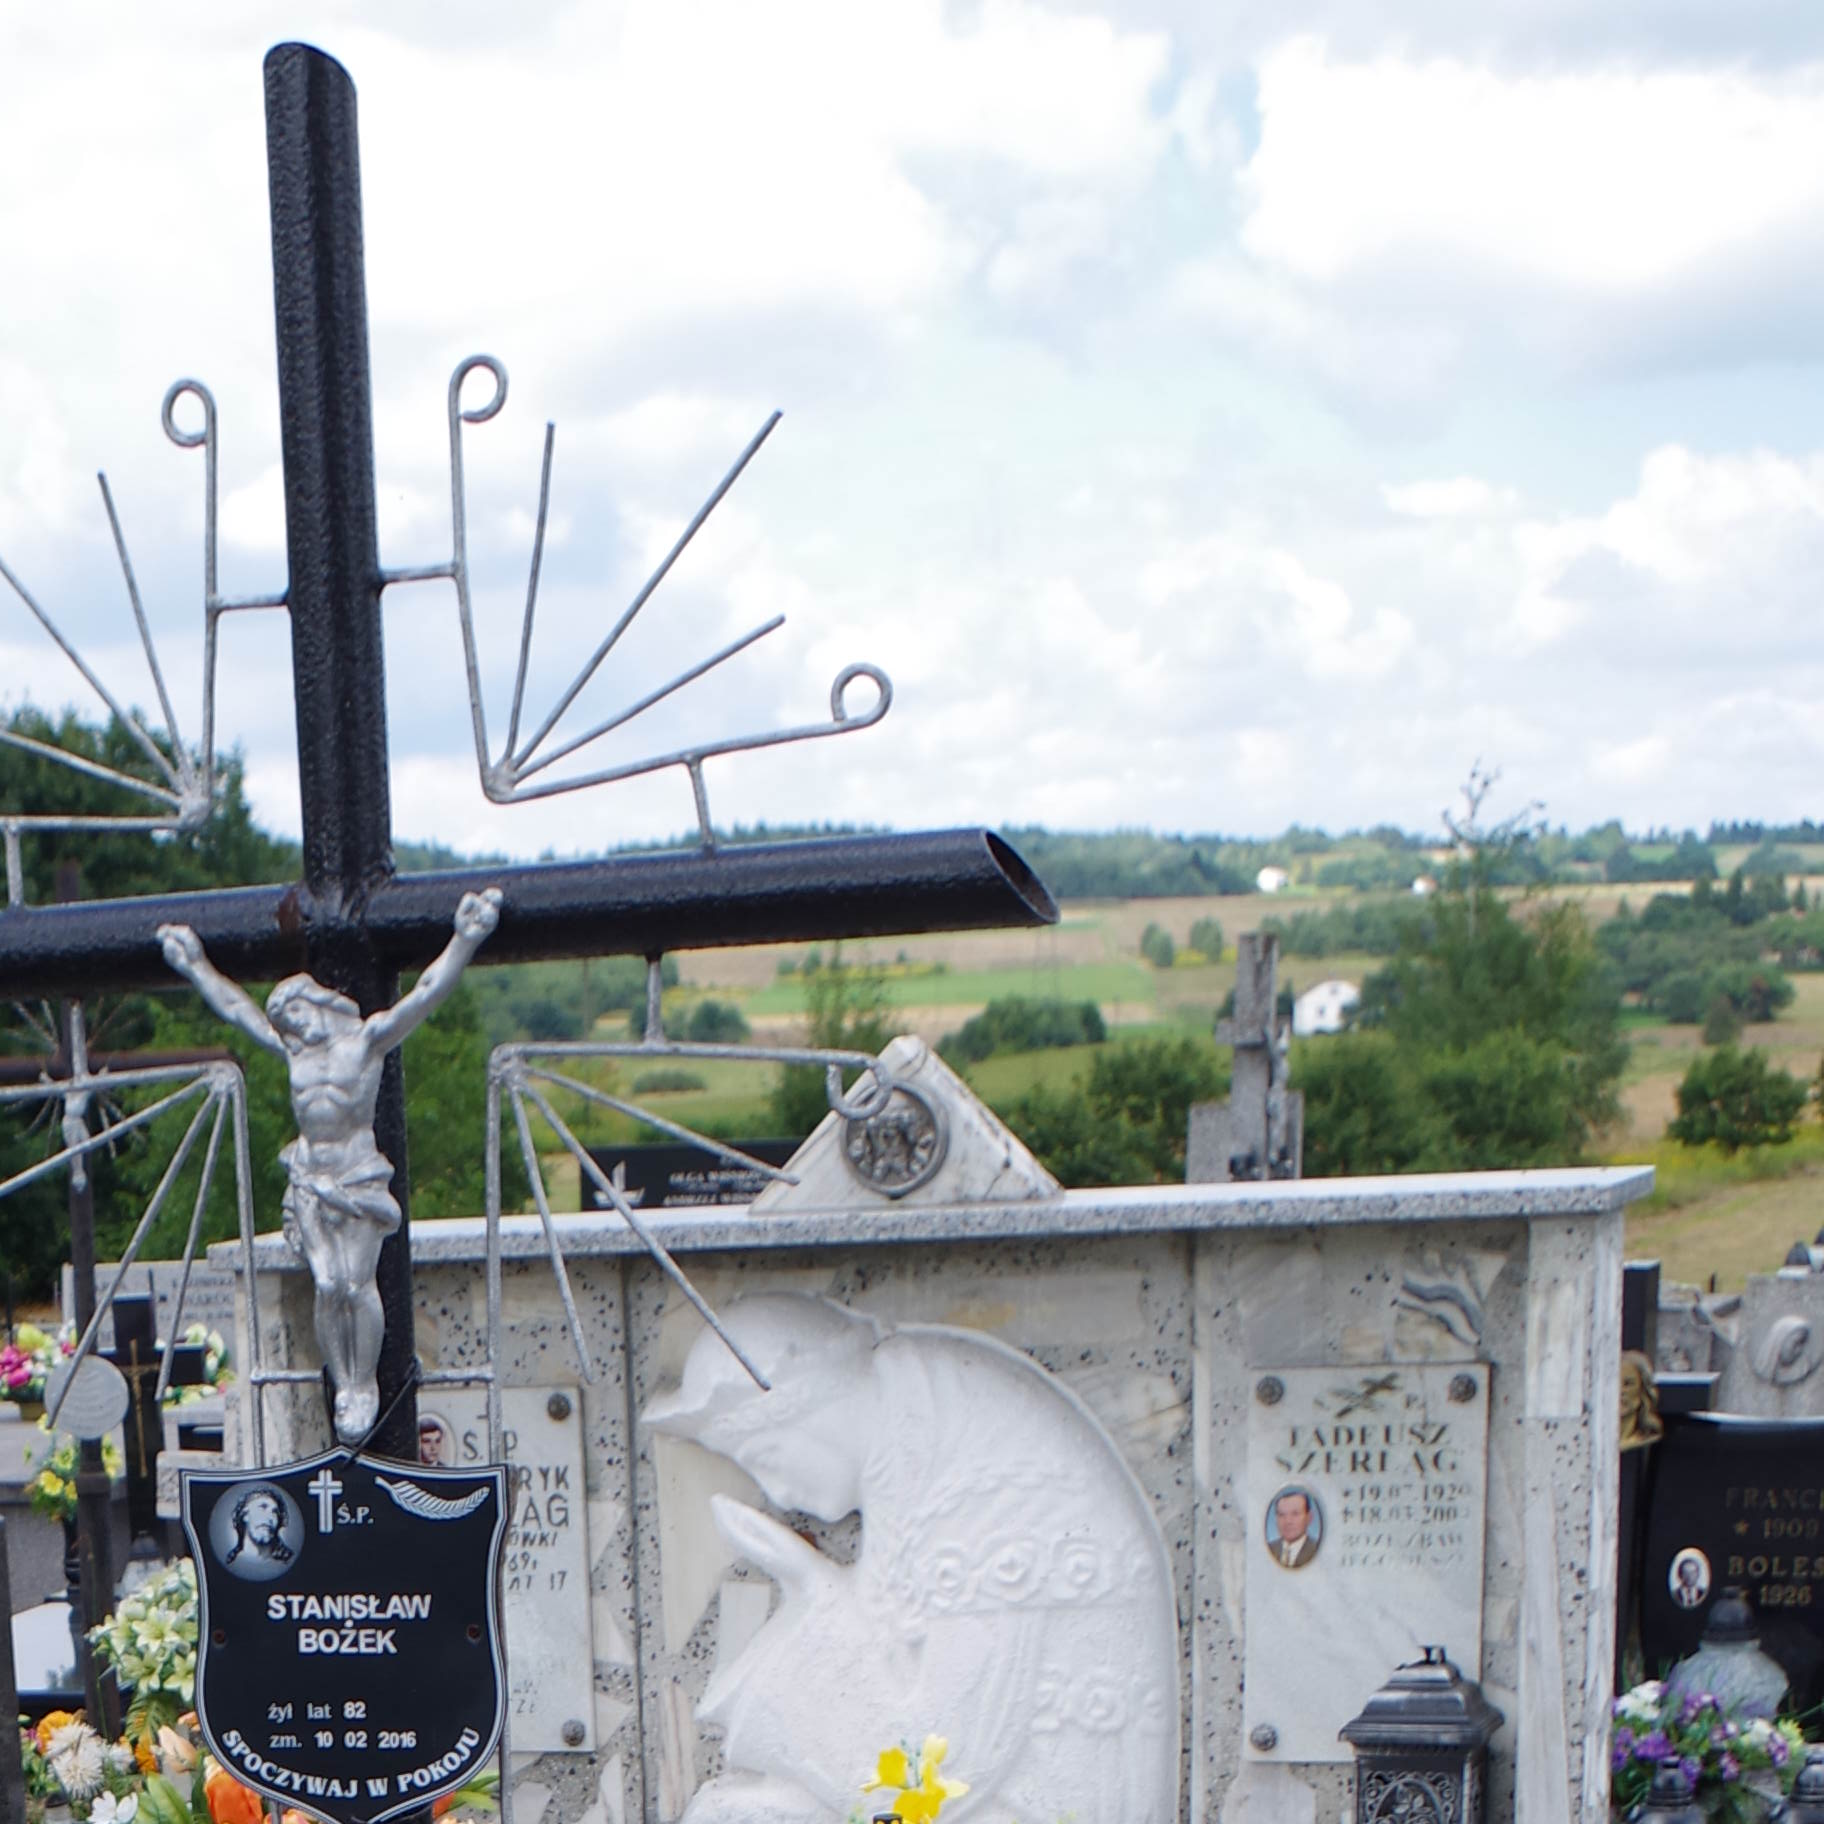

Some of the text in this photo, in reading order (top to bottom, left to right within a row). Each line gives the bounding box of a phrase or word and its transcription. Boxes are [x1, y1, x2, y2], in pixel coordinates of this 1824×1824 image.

[336, 1502, 375, 1525] Ś.P.
[267, 1594, 432, 1621] STANISŁAW
[298, 1620, 398, 1655] BOŻEK
[267, 1701, 367, 1722] żył lat 82
[269, 1731, 417, 1749] zm. 10 02 2016
[222, 1727, 481, 1799] SPOCZYWAJ W POKOJU
